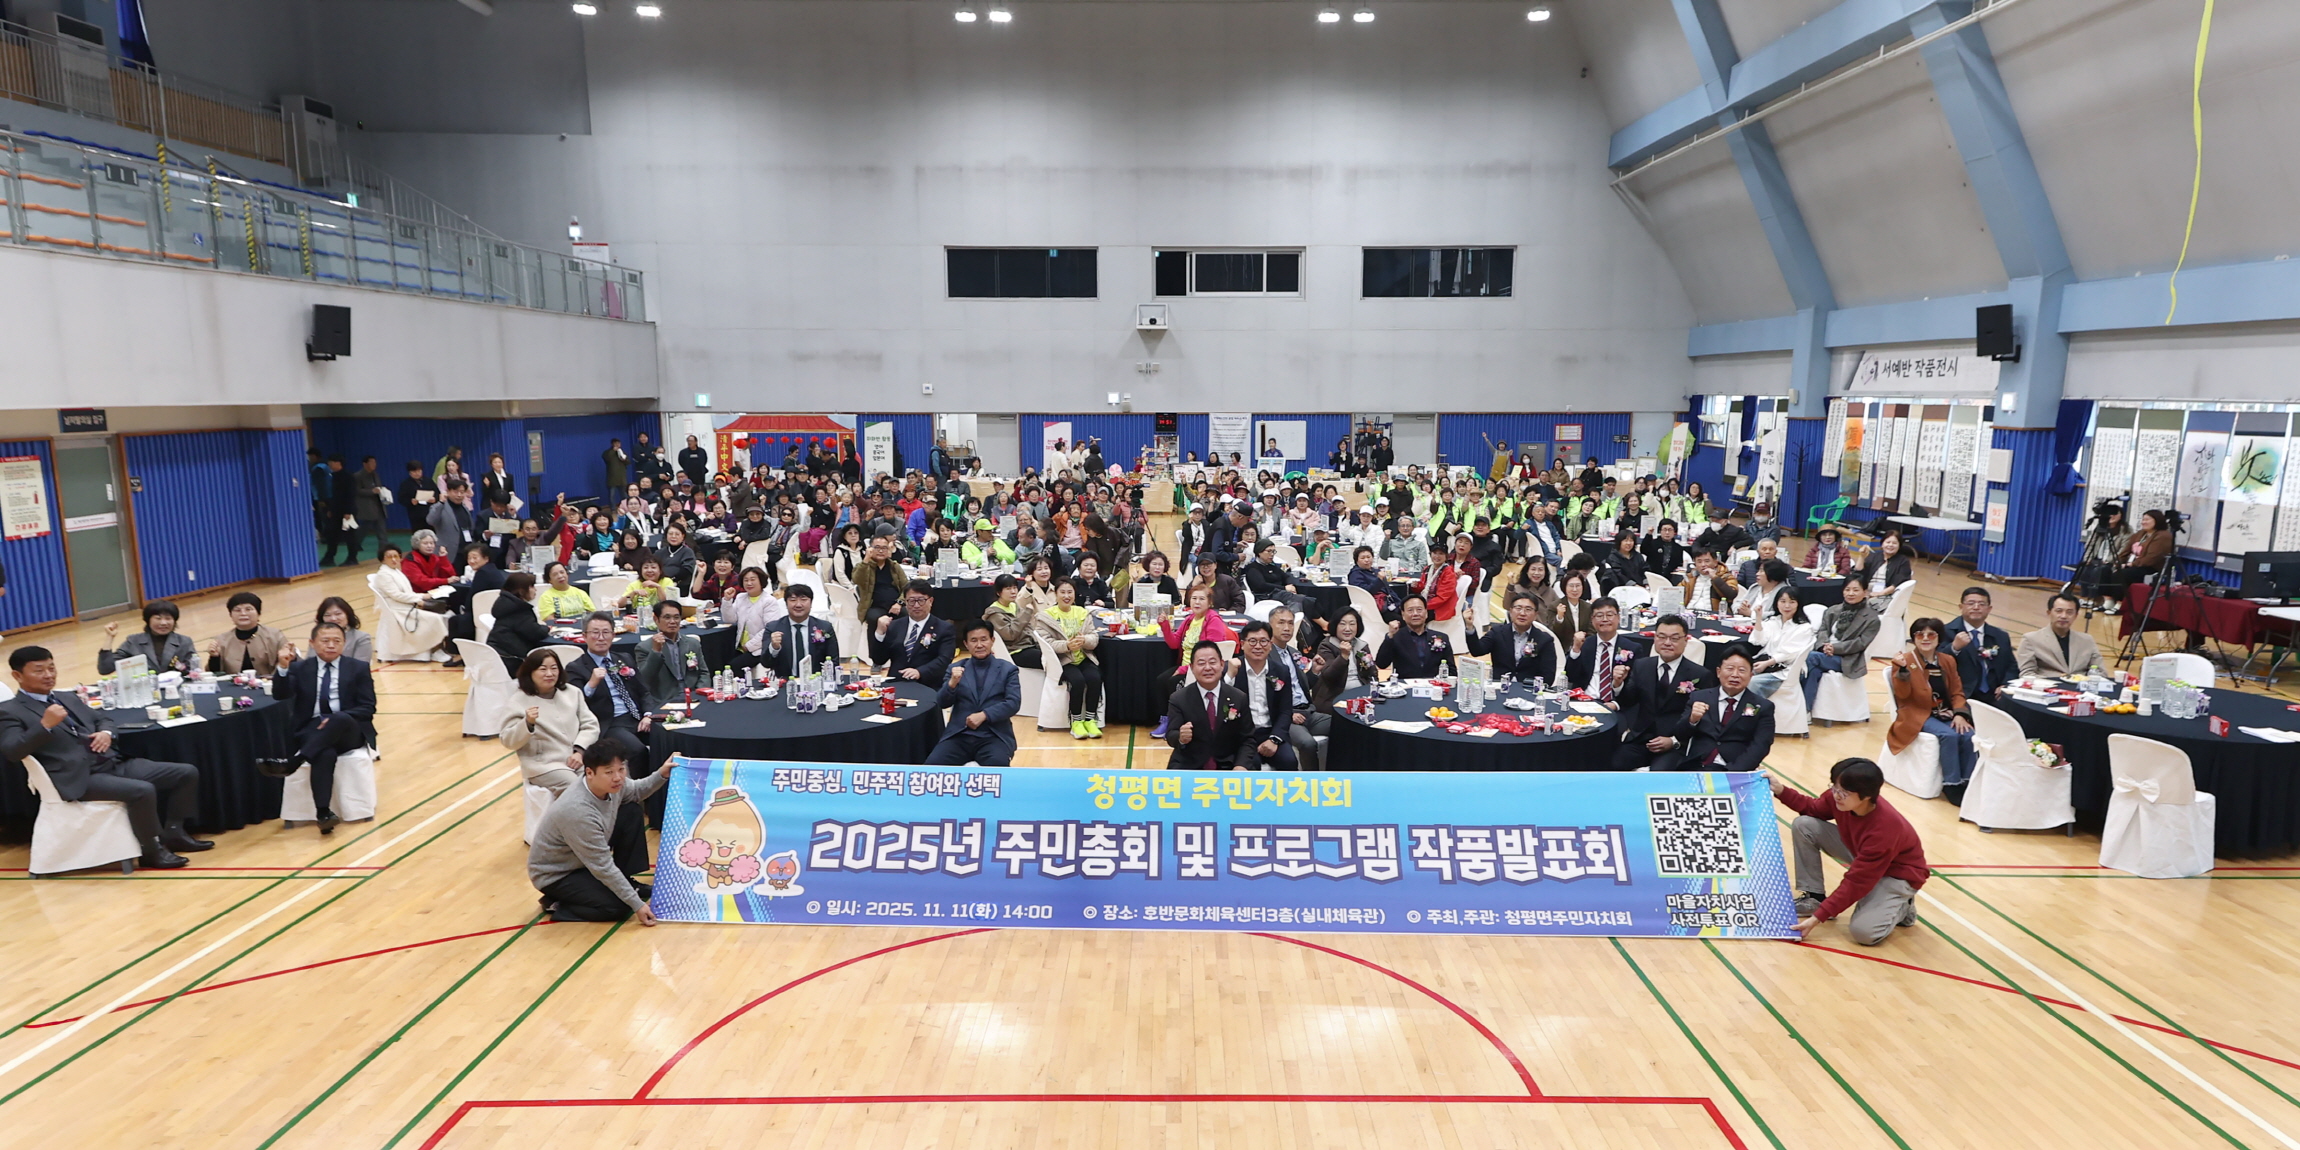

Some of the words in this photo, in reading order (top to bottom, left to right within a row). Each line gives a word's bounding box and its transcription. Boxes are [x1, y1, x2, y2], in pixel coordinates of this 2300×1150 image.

[1881, 359, 1913, 378] 서예반
[1914, 356, 1959, 377] 작품전시
[719, 434, 731, 477] 清平中文
[773, 768, 847, 793] 주민중심.
[853, 769, 904, 794] 민주적
[908, 770, 962, 796] 참여와
[965, 769, 1001, 798] 선택
[1086, 774, 1182, 810] 청평면
[1191, 777, 1352, 809] 주민자치회
[806, 819, 985, 879] 2025년
[992, 820, 1162, 880] 주민총회
[1174, 822, 1217, 881] 및
[1228, 823, 1403, 882] 프로그램
[1408, 825, 1632, 884] 작품발표회
[826, 899, 861, 916] 일시:
[865, 901, 918, 917] 2025.
[923, 901, 946, 918] 11.
[951, 900, 998, 920] 11(화)
[1003, 903, 1053, 919] 14:00
[1666, 893, 1756, 911] 마을자치사업
[1103, 904, 1137, 921] 장소:
[1143, 904, 1386, 924] 호반문화체육센터3층(실내체육관)
[1427, 908, 1500, 926] 주최,주관:
[1505, 908, 1633, 926] 청평면주민자치회
[1669, 913, 1731, 929] 사전투표
[1735, 912, 1760, 928] QR
